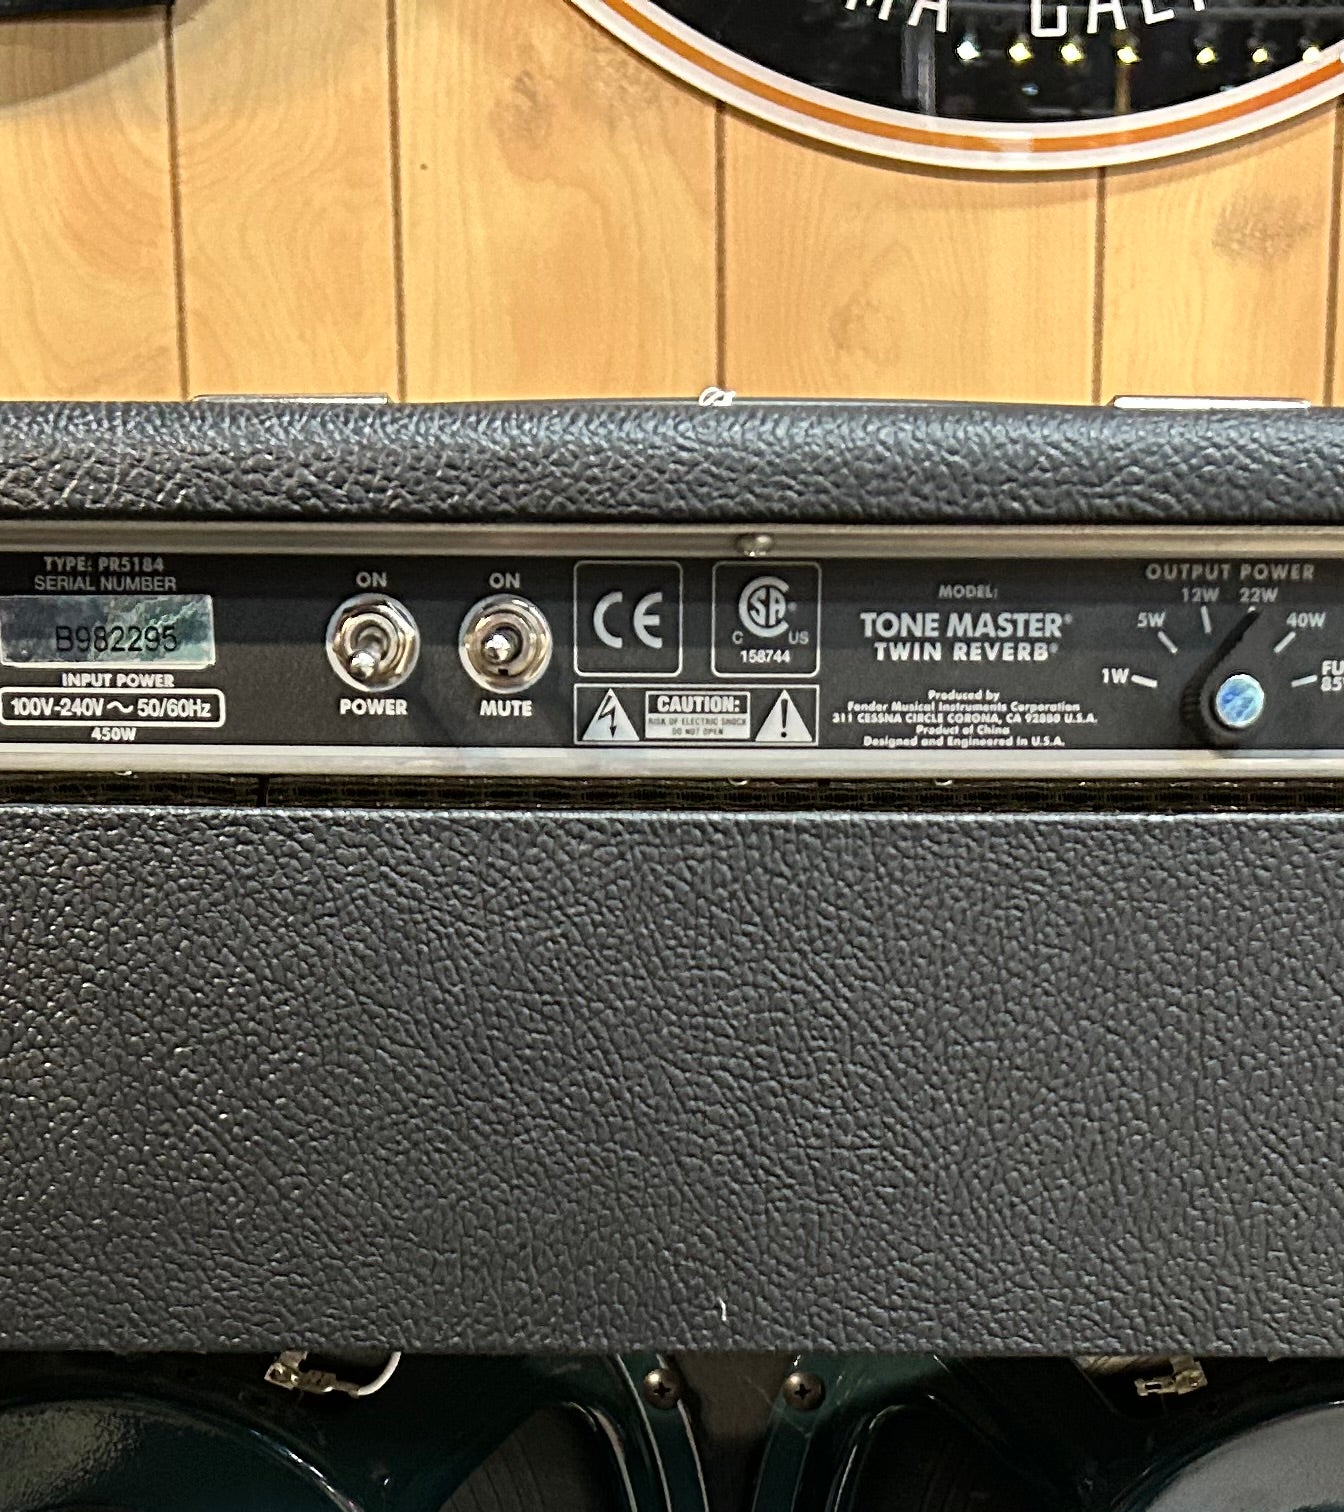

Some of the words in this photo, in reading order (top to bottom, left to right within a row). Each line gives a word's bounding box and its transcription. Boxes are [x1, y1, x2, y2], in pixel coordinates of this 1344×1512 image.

[43, 556, 93, 573] TYPE:
[97, 556, 165, 573] PR5184
[1146, 563, 1231, 581] OUTPUT
[1239, 563, 1315, 581] POWER
[33, 576, 97, 593] SERIAL
[99, 576, 178, 593] NUMBER
[356, 571, 388, 588] ON
[489, 571, 521, 588] ON
[1181, 587, 1220, 603] 12W
[1239, 587, 1279, 603] 22W
[860, 612, 940, 638] TONE
[1137, 612, 1166, 629] 5W
[1285, 612, 1327, 629] 40W
[56, 624, 179, 655] B982295
[788, 631, 809, 645] US
[874, 642, 942, 661] TWIN
[62, 674, 111, 688] INPUT
[116, 674, 175, 688] POWER
[1101, 668, 1130, 684] 1W
[927, 689, 983, 701] Produced
[985, 689, 1000, 702] by
[10, 697, 105, 718] 100V-240V
[136, 695, 212, 719] 50/60Hz
[339, 699, 408, 717] POWER
[479, 700, 533, 717] MUTE
[657, 696, 740, 713] CAUTION:
[847, 701, 888, 712] Fender
[891, 701, 935, 712] Musical
[938, 701, 1007, 712] Instruments
[1010, 701, 1081, 712] Corporation
[832, 713, 854, 724] 311
[857, 713, 902, 724] CESSNA
[905, 713, 944, 724] CIRCLE
[1006, 713, 1022, 724] CA
[1064, 713, 1098, 724] U.S.A.
[90, 726, 136, 742] 450W
[915, 725, 960, 735] Product
[962, 725, 975, 735] of
[977, 725, 1010, 735] China
[863, 736, 918, 748] Designed
[921, 736, 944, 747] and
[947, 736, 1013, 748] Engineered
[1031, 737, 1065, 747] U.S.A.
